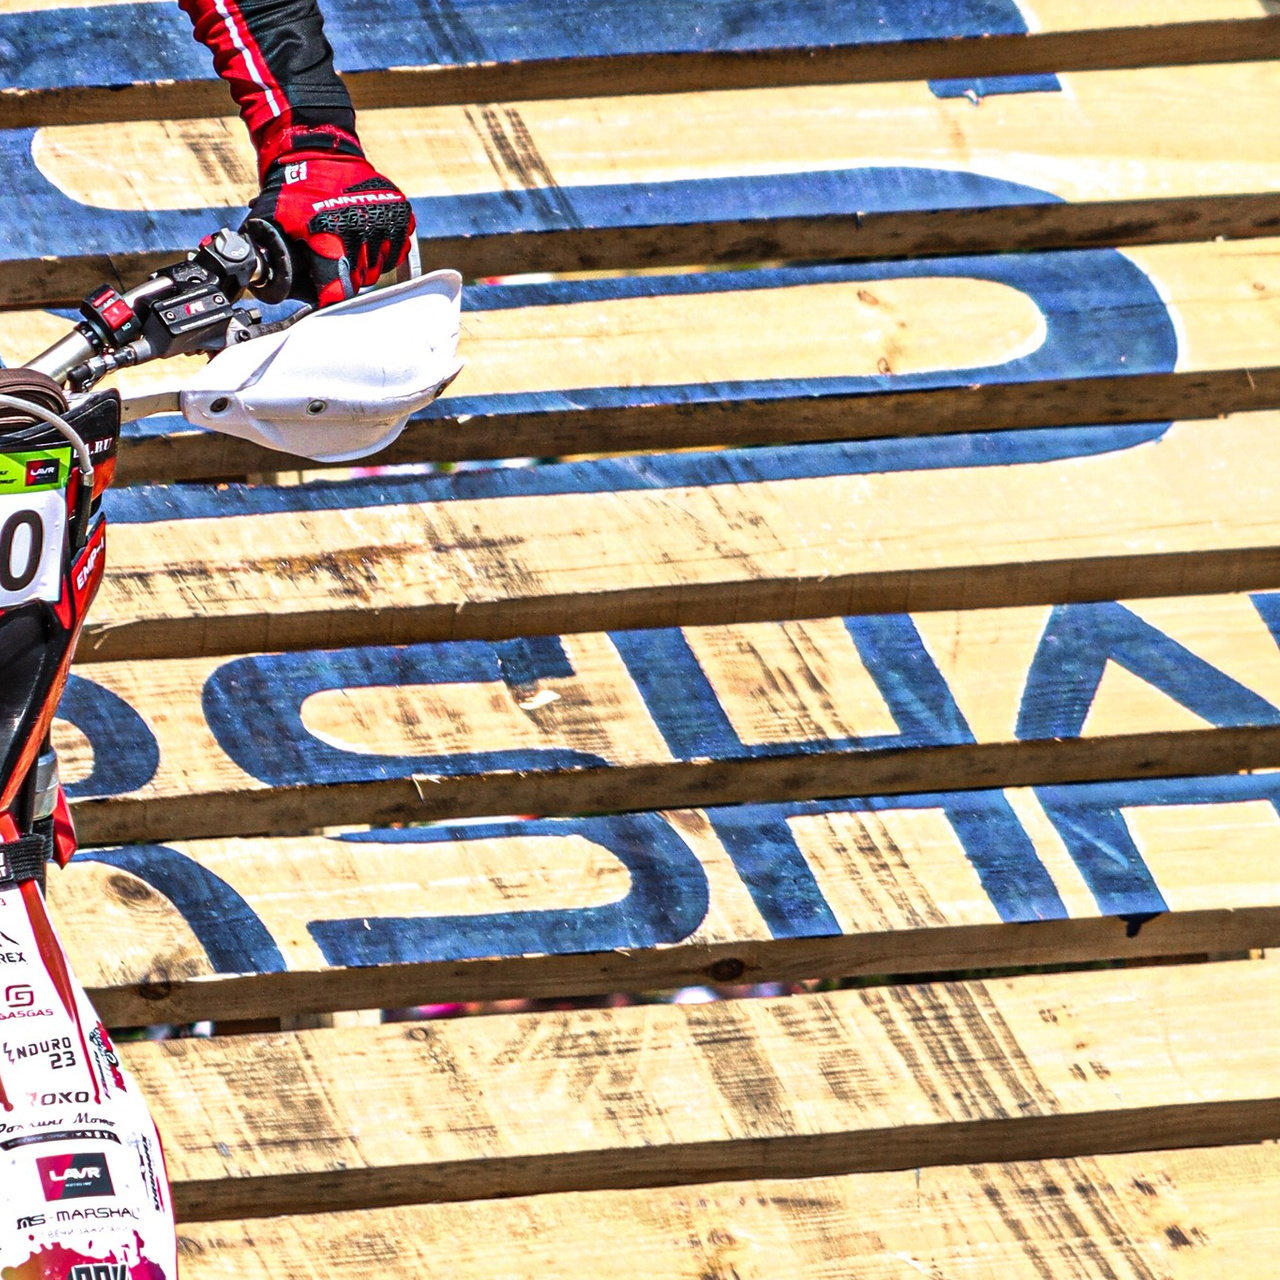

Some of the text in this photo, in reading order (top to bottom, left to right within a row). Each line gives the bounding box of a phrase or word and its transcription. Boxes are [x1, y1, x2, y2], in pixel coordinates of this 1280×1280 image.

[312, 193, 402, 212] FINNTRAIL
[30, 466, 55, 476] LAVR
[49, 1051, 76, 1070] 23
[49, 1166, 102, 1182] LAVR
[56, 1207, 140, 1222] MARSHAL
